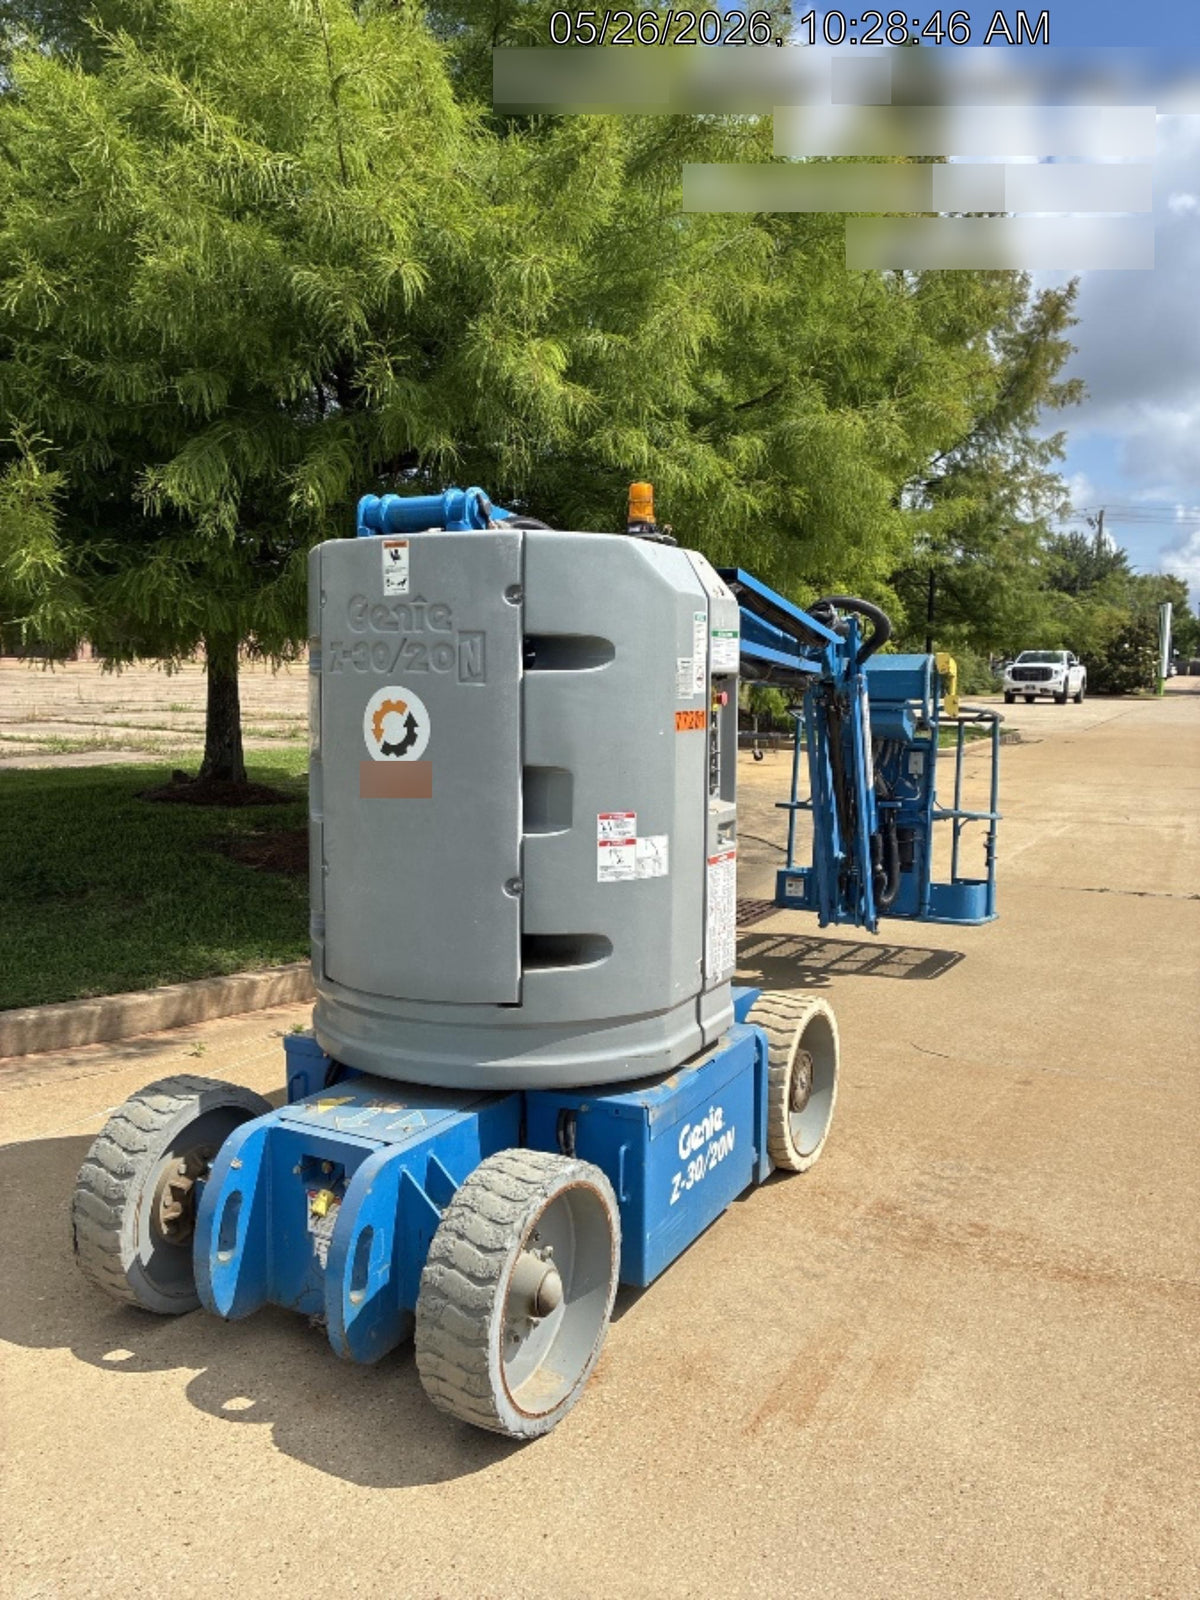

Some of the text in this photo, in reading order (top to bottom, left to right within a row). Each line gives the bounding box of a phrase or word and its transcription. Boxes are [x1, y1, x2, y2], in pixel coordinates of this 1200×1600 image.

[348, 594, 452, 633] Genie
[679, 1105, 725, 1160] Genie
[670, 1124, 735, 1206] Z-30/20N
